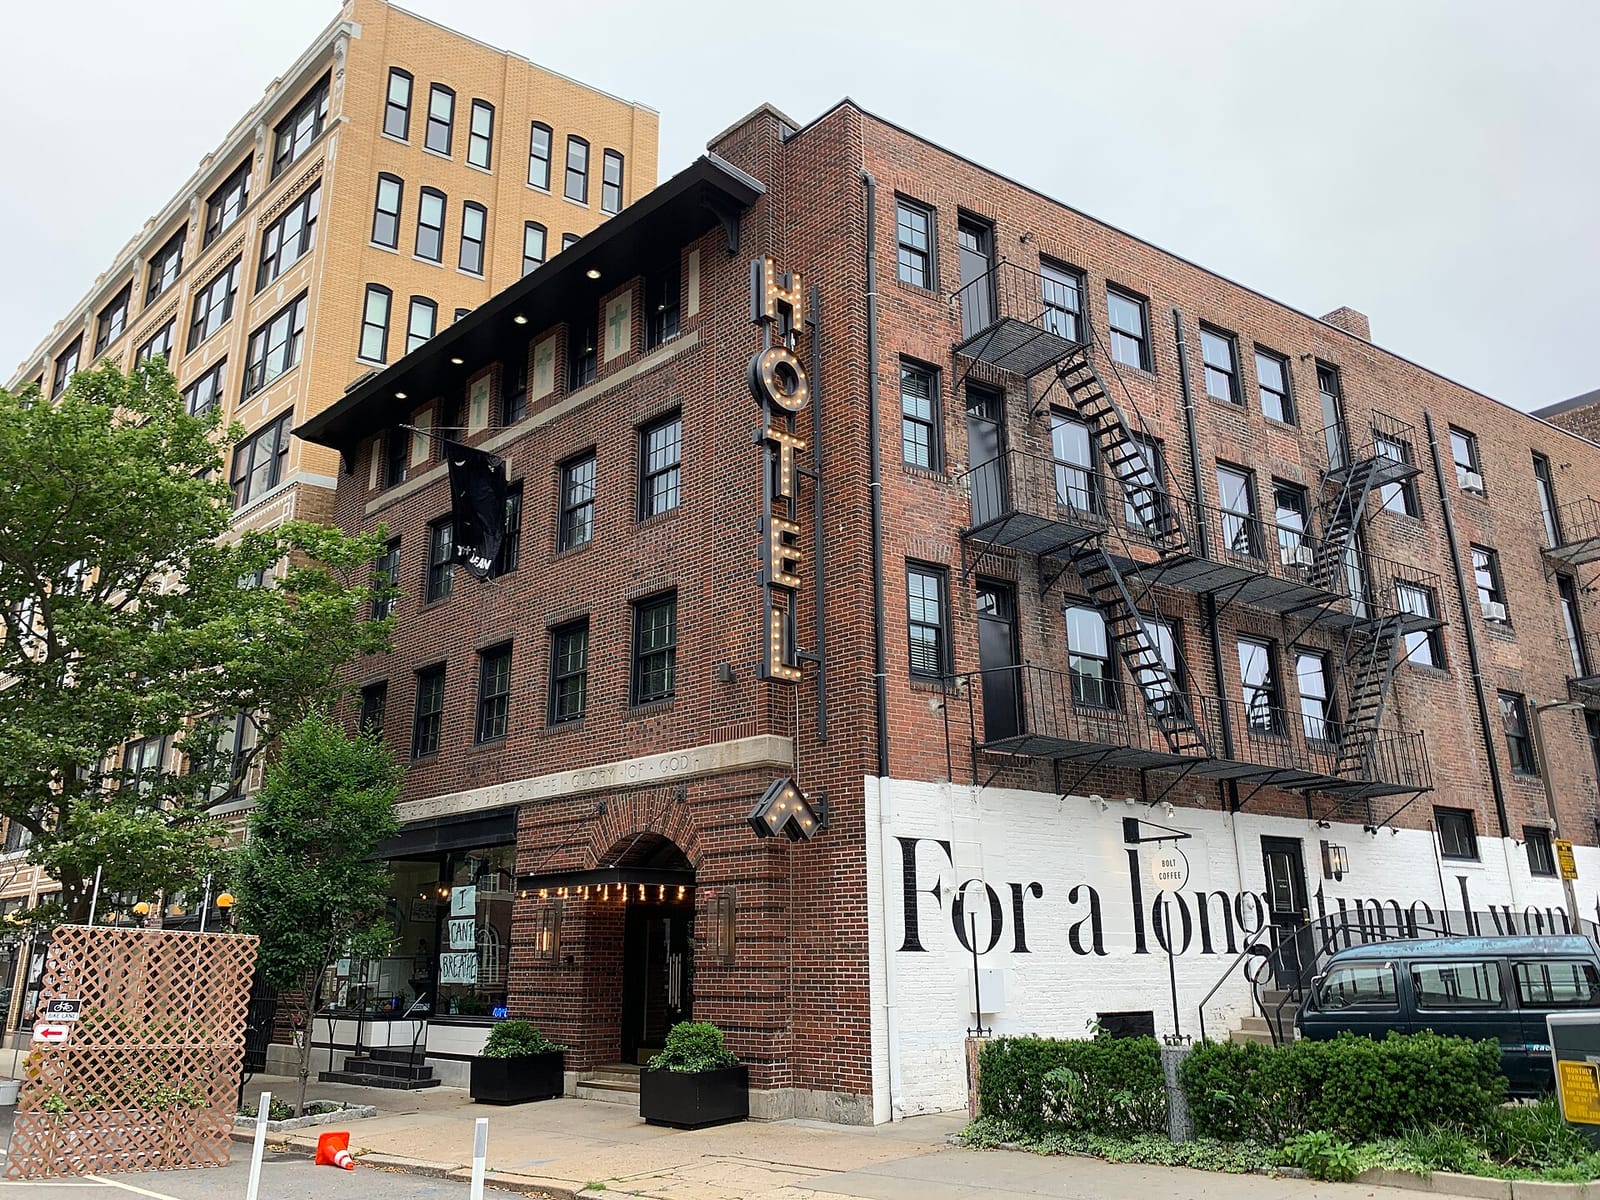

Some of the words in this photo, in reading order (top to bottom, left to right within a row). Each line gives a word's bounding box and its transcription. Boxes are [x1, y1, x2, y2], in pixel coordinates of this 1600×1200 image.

[750, 254, 810, 683] HOTEL
[534, 778, 557, 794] THE
[571, 766, 616, 788] GLORY
[628, 762, 645, 779] OF
[659, 755, 689, 773] GOD
[1158, 871, 1182, 880] COFFEE
[1161, 859, 1176, 868] BOLT
[458, 888, 467, 910] I
[891, 836, 1043, 955] For
[1068, 883, 1110, 956] a
[1124, 848, 1270, 985] long
[1313, 876, 1435, 955] time
[1487, 904, 1582, 937] wen
[442, 954, 477, 979] BREATHE
